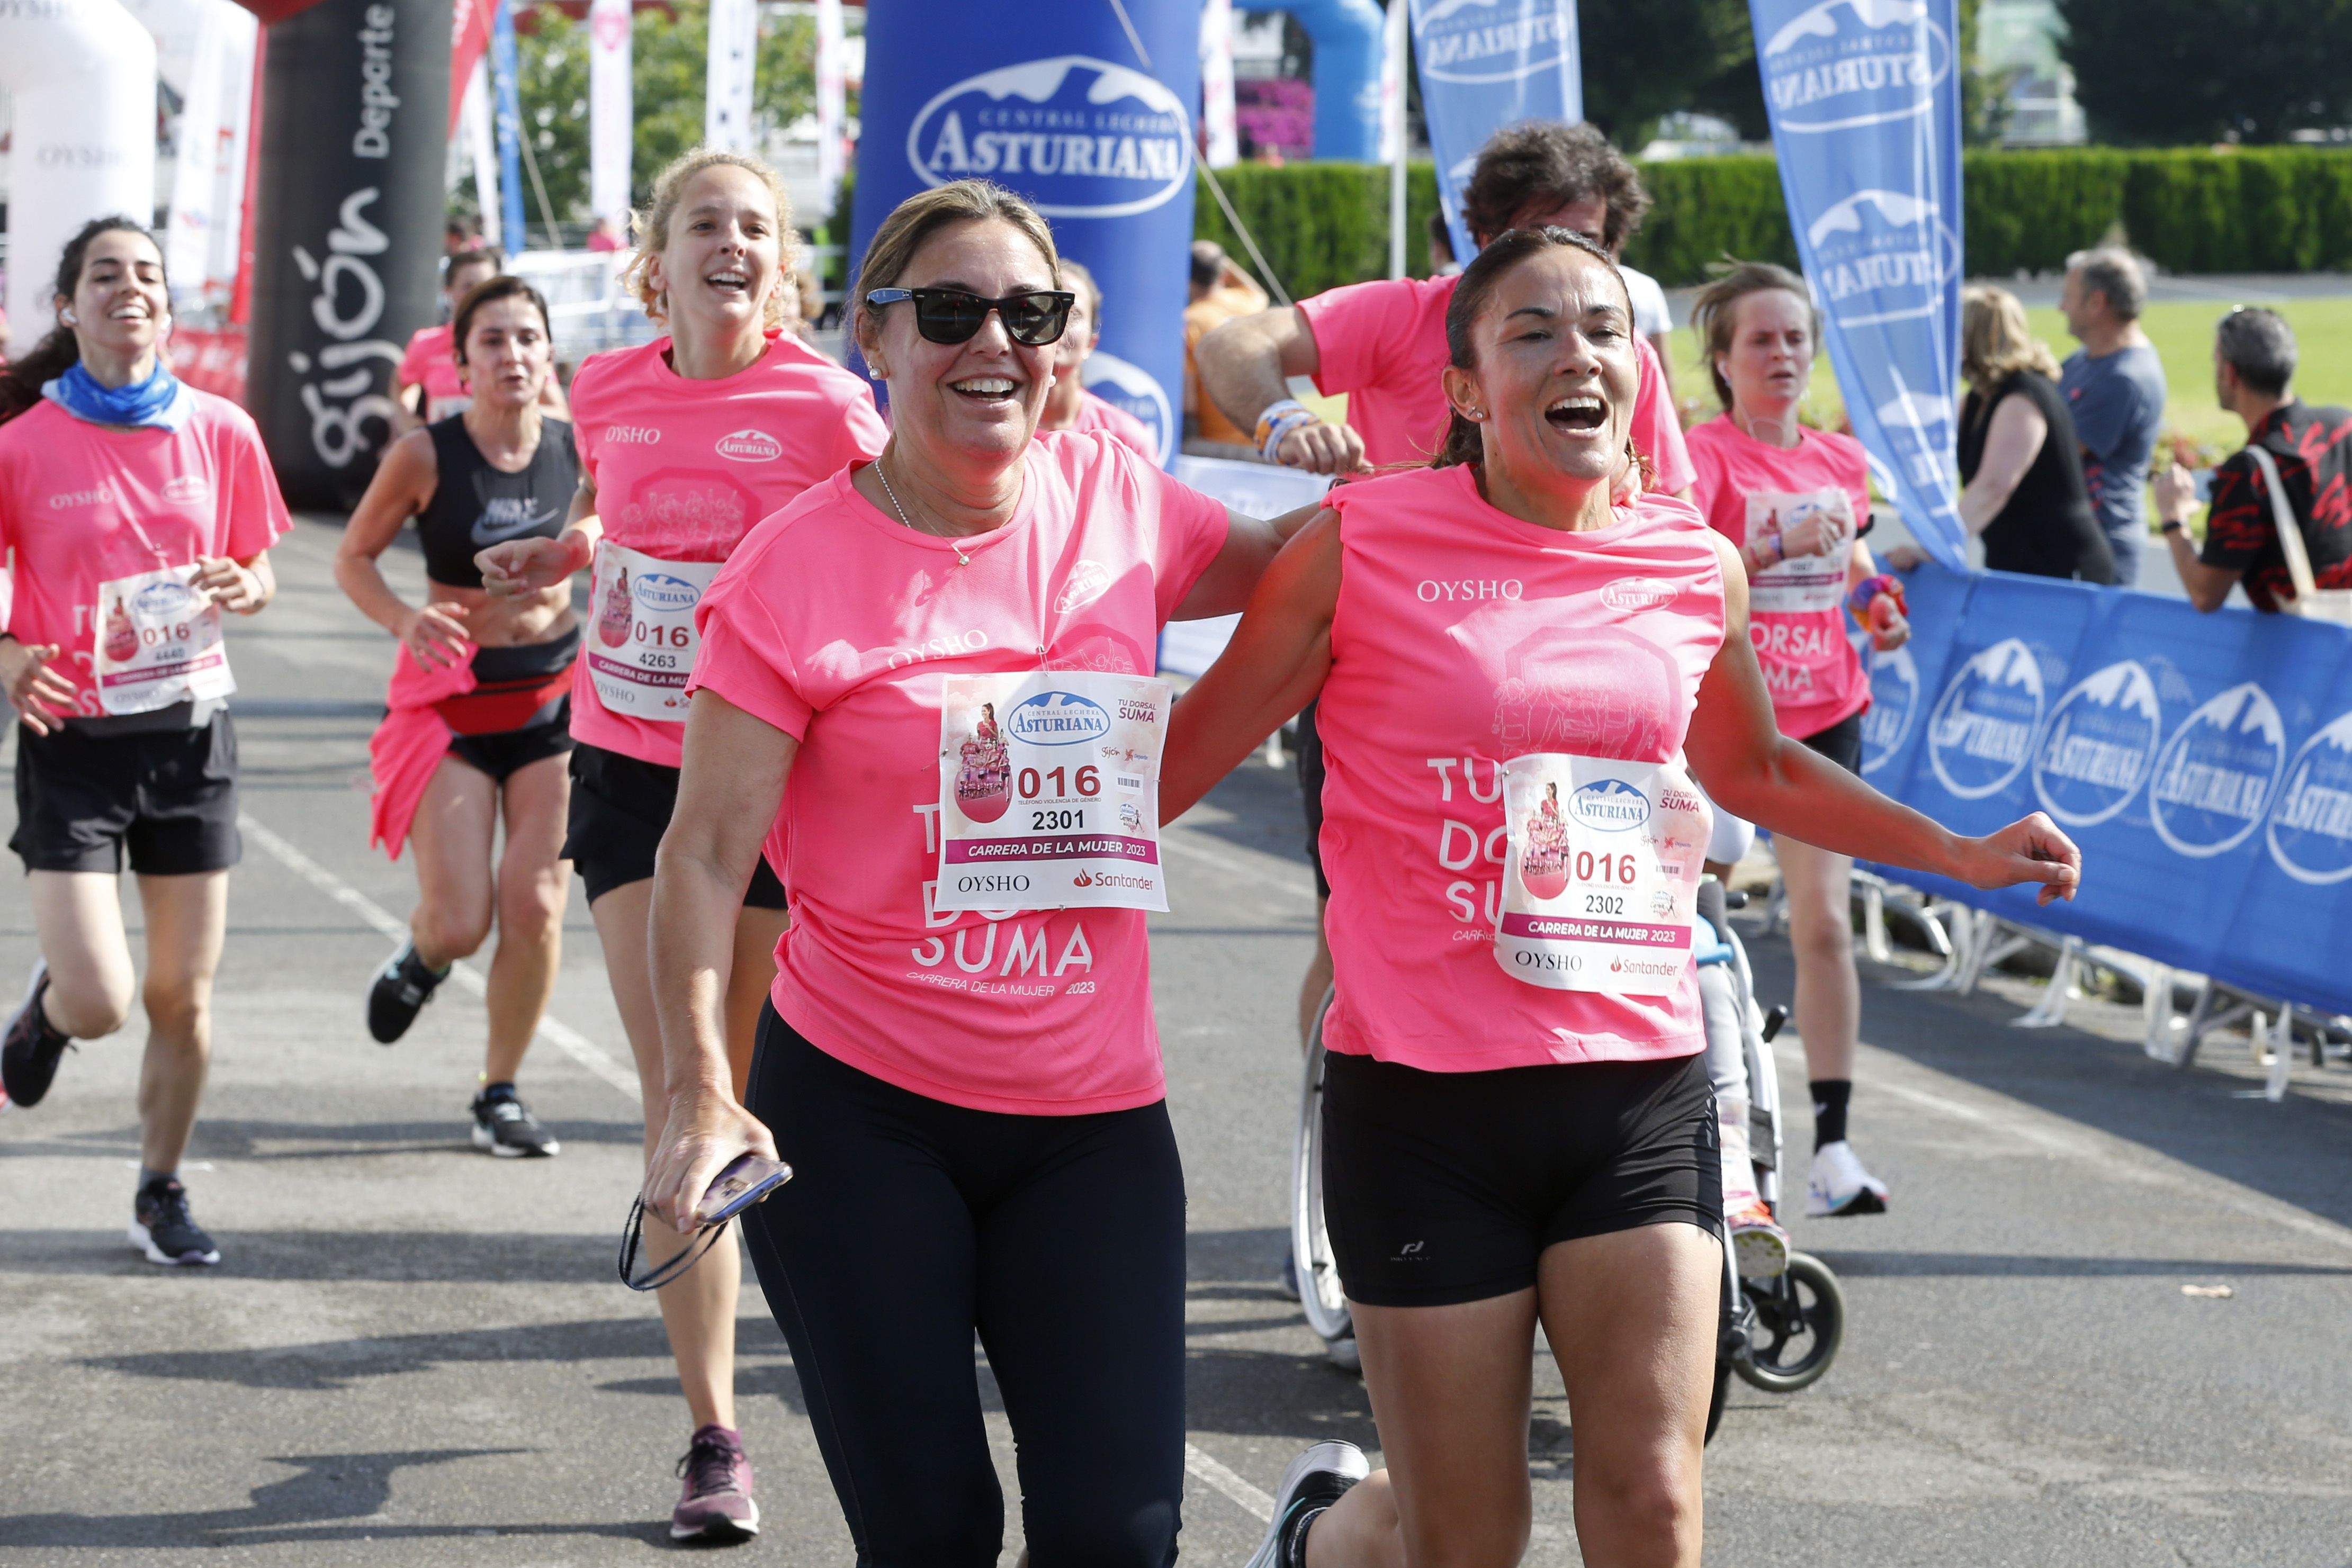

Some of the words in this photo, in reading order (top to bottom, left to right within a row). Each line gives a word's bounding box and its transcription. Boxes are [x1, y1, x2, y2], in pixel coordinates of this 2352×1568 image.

[351, 3, 401, 159] Deporte
[927, 110, 1179, 181] ASTURIANA
[605, 426, 660, 445] OYSHO
[637, 583, 695, 603] ASTURIANA
[1417, 579, 1523, 602] OYSHO
[143, 621, 191, 645] 016
[636, 620, 690, 647] 016
[888, 629, 989, 669] OYSHO
[639, 652, 676, 669] 4263
[1118, 707, 1155, 723] SUMA
[1129, 700, 1156, 710] DORSAL
[1015, 713, 1104, 733] ASTURIANA
[1018, 765, 1101, 799] 016
[1575, 795, 1643, 821] ASTURIANA
[1659, 797, 1700, 813] SUMA
[1033, 809, 1084, 831] 2301
[968, 843, 1028, 858] CARRERA
[1031, 842, 1052, 855] DE
[1055, 842, 1074, 853] LA
[1078, 841, 1123, 853] MUJER
[1126, 843, 1146, 857] 2023
[1576, 851, 1636, 885] 016
[958, 875, 1030, 892] OYSHO
[1095, 871, 1153, 891] Santander
[1585, 895, 1623, 915] 2302
[1528, 920, 1582, 939] CARRERA
[1584, 924, 1599, 938] DE
[1600, 925, 1614, 940] LA
[1615, 926, 1648, 942] MUJER
[1650, 930, 1675, 942] 2023
[911, 922, 1093, 978] SUMA
[1515, 950, 1582, 971] OYSHO
[1623, 959, 1678, 977] Santander
[906, 971, 966, 990] CARRERA
[971, 980, 990, 994] DE
[991, 983, 1007, 995] LA
[1010, 985, 1055, 996] MUJER
[1065, 981, 1095, 995] 2023
